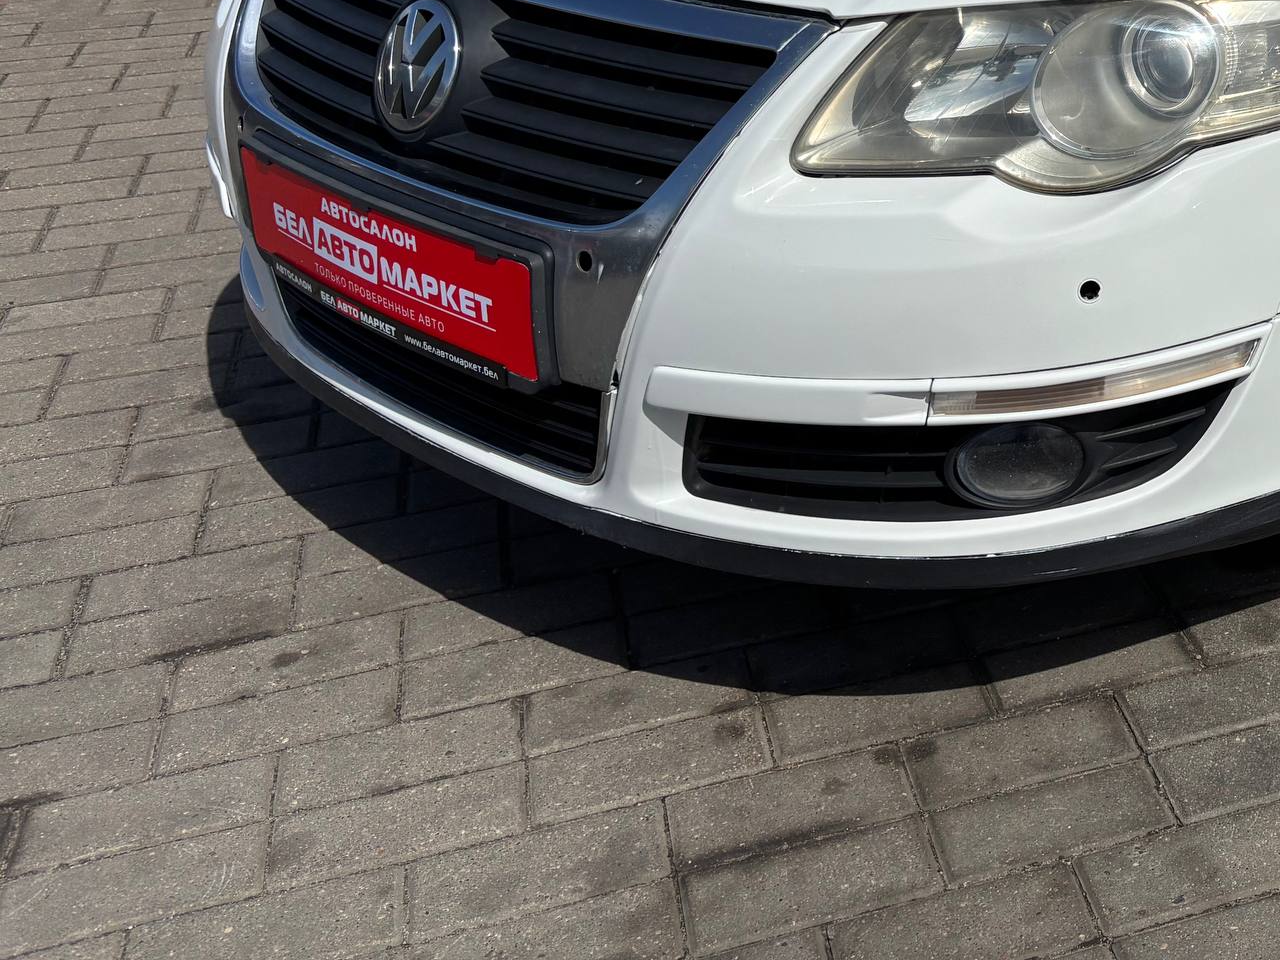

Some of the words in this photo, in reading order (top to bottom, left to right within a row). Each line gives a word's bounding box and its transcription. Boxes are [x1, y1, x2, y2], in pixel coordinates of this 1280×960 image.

[321, 197, 417, 252] АВТОСАЛОН
[276, 262, 313, 293] АВТОСАЛОН
[404, 334, 499, 381] www.белавтомаркет.бел
[314, 262, 347, 288] ТОЛЬКО
[348, 280, 416, 321] ПРОВЕРЕННЫЕ
[418, 313, 445, 333] АВТО
